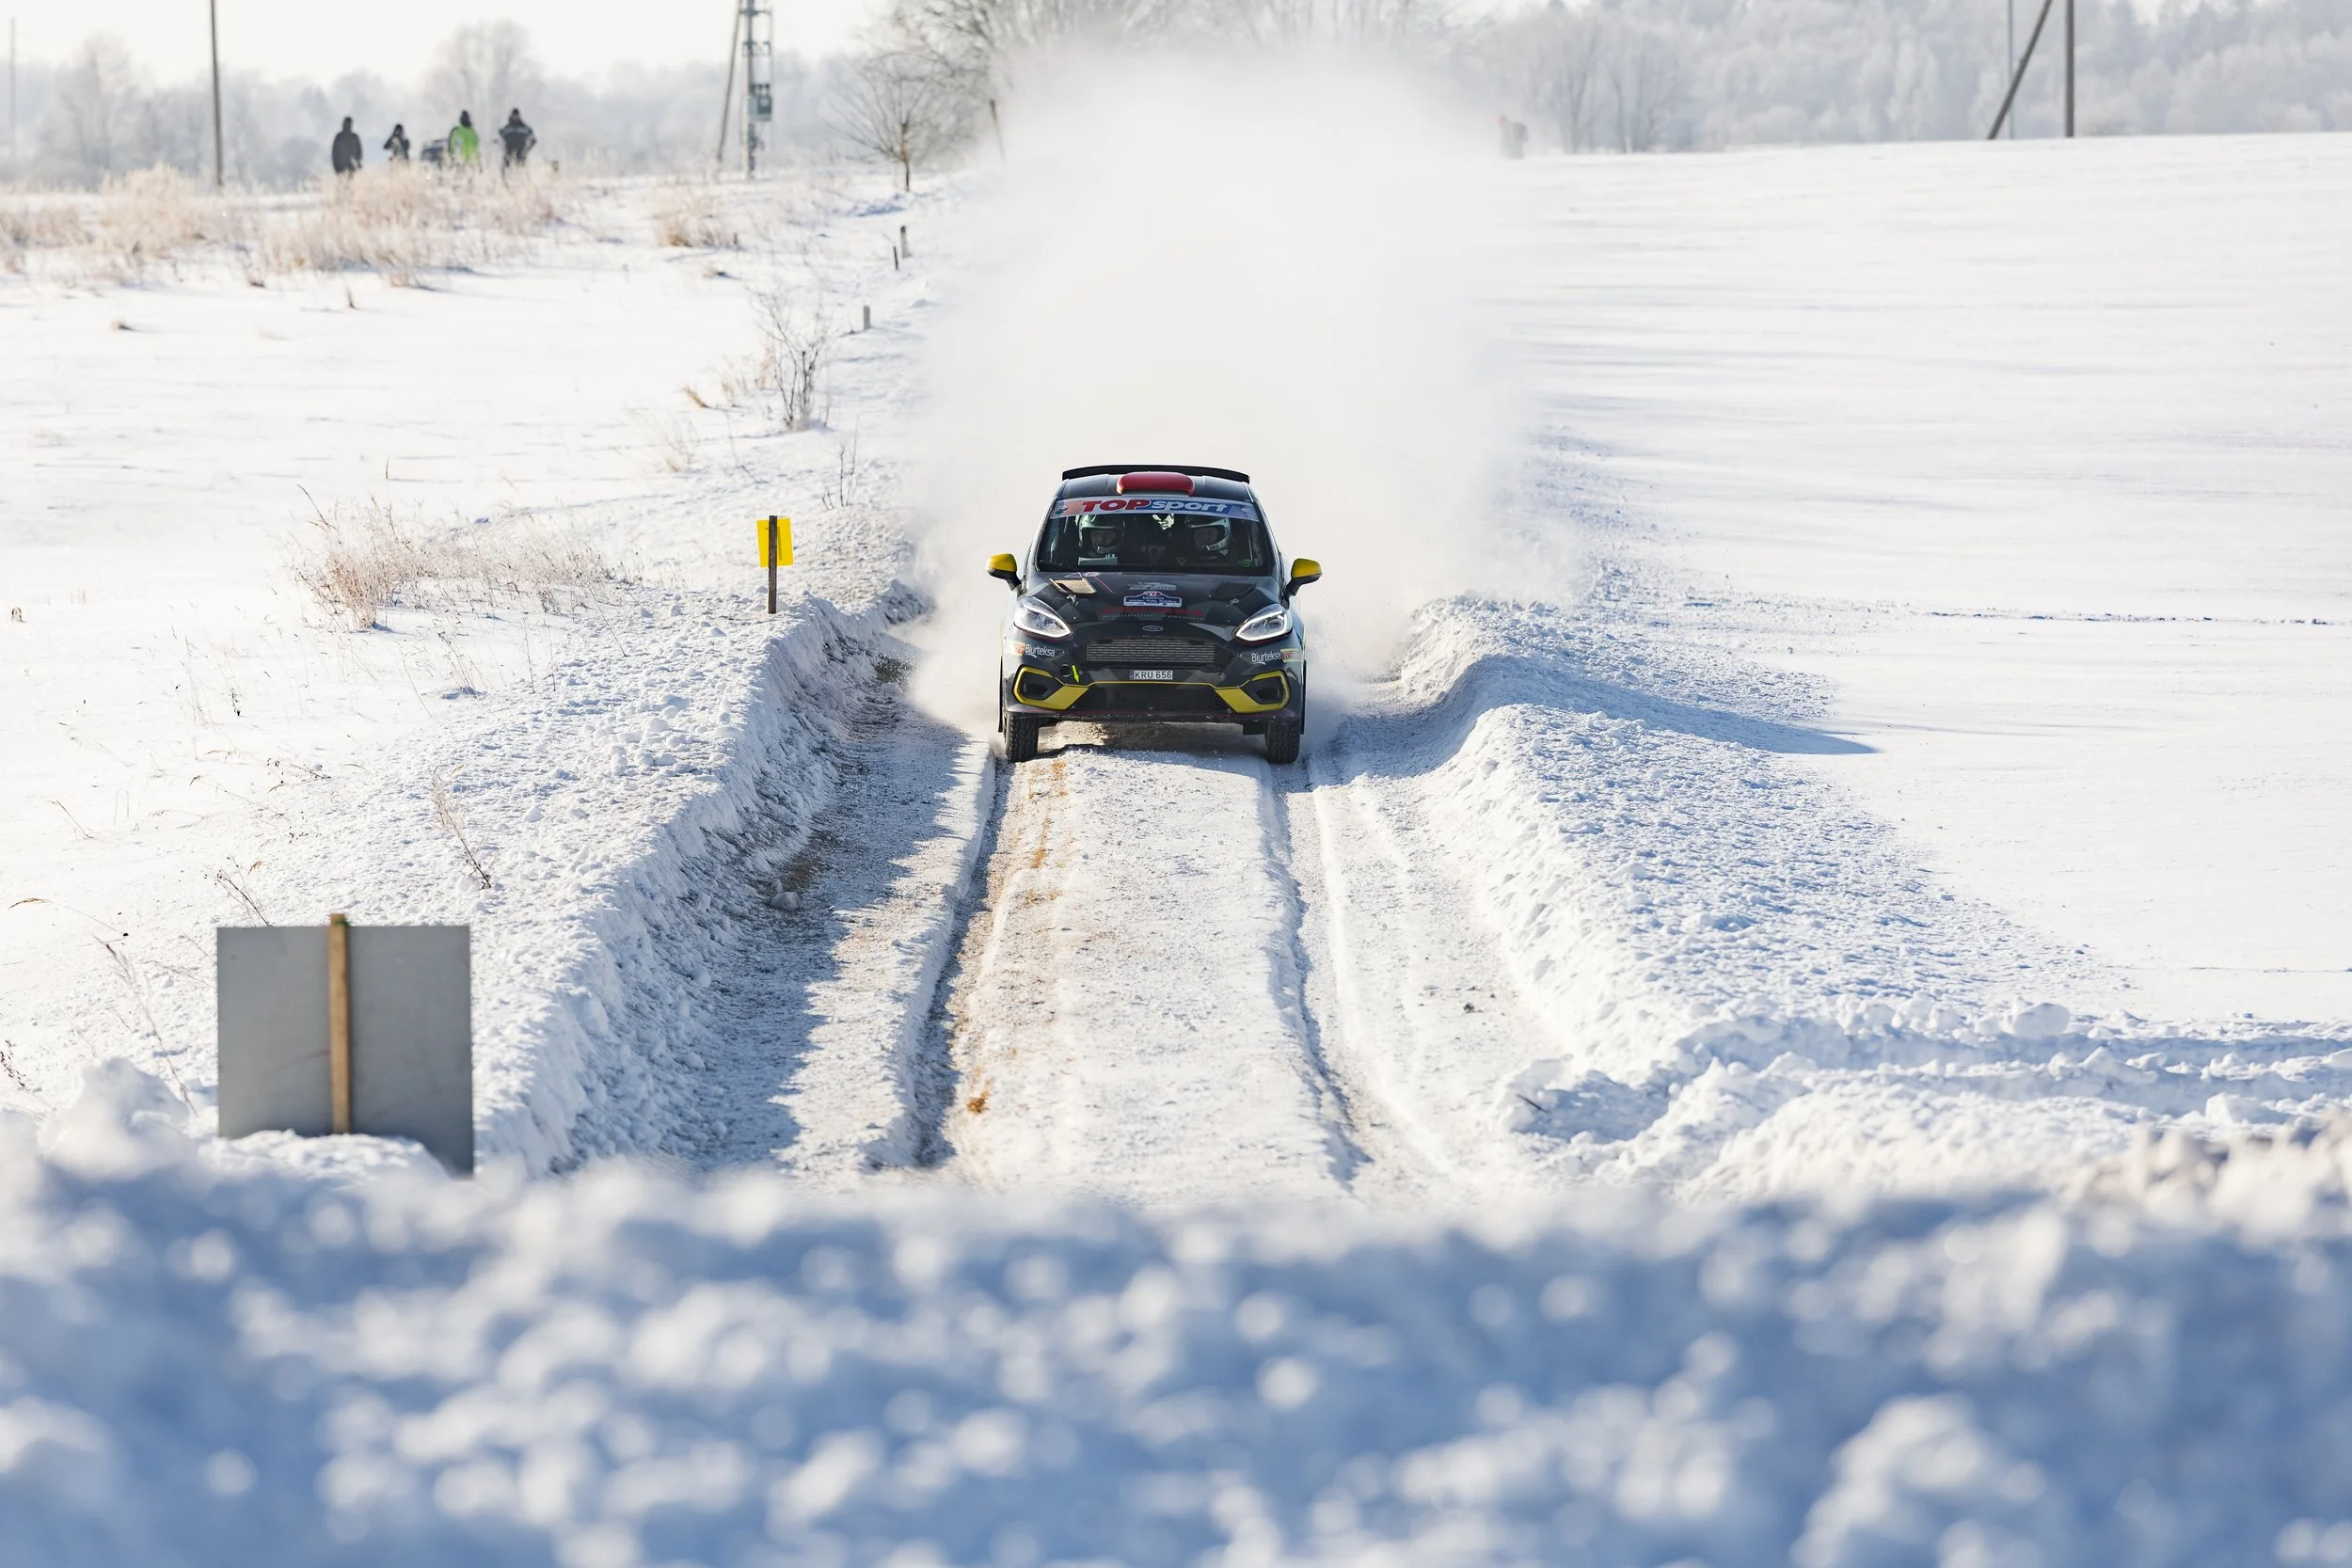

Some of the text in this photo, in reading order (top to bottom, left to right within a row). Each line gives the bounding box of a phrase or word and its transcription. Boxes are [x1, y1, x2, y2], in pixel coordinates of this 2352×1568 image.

[1025, 643, 1056, 657] Biurteksa
[1251, 651, 1281, 664] Biurteksa
[1135, 671, 1172, 679] KRU 656
